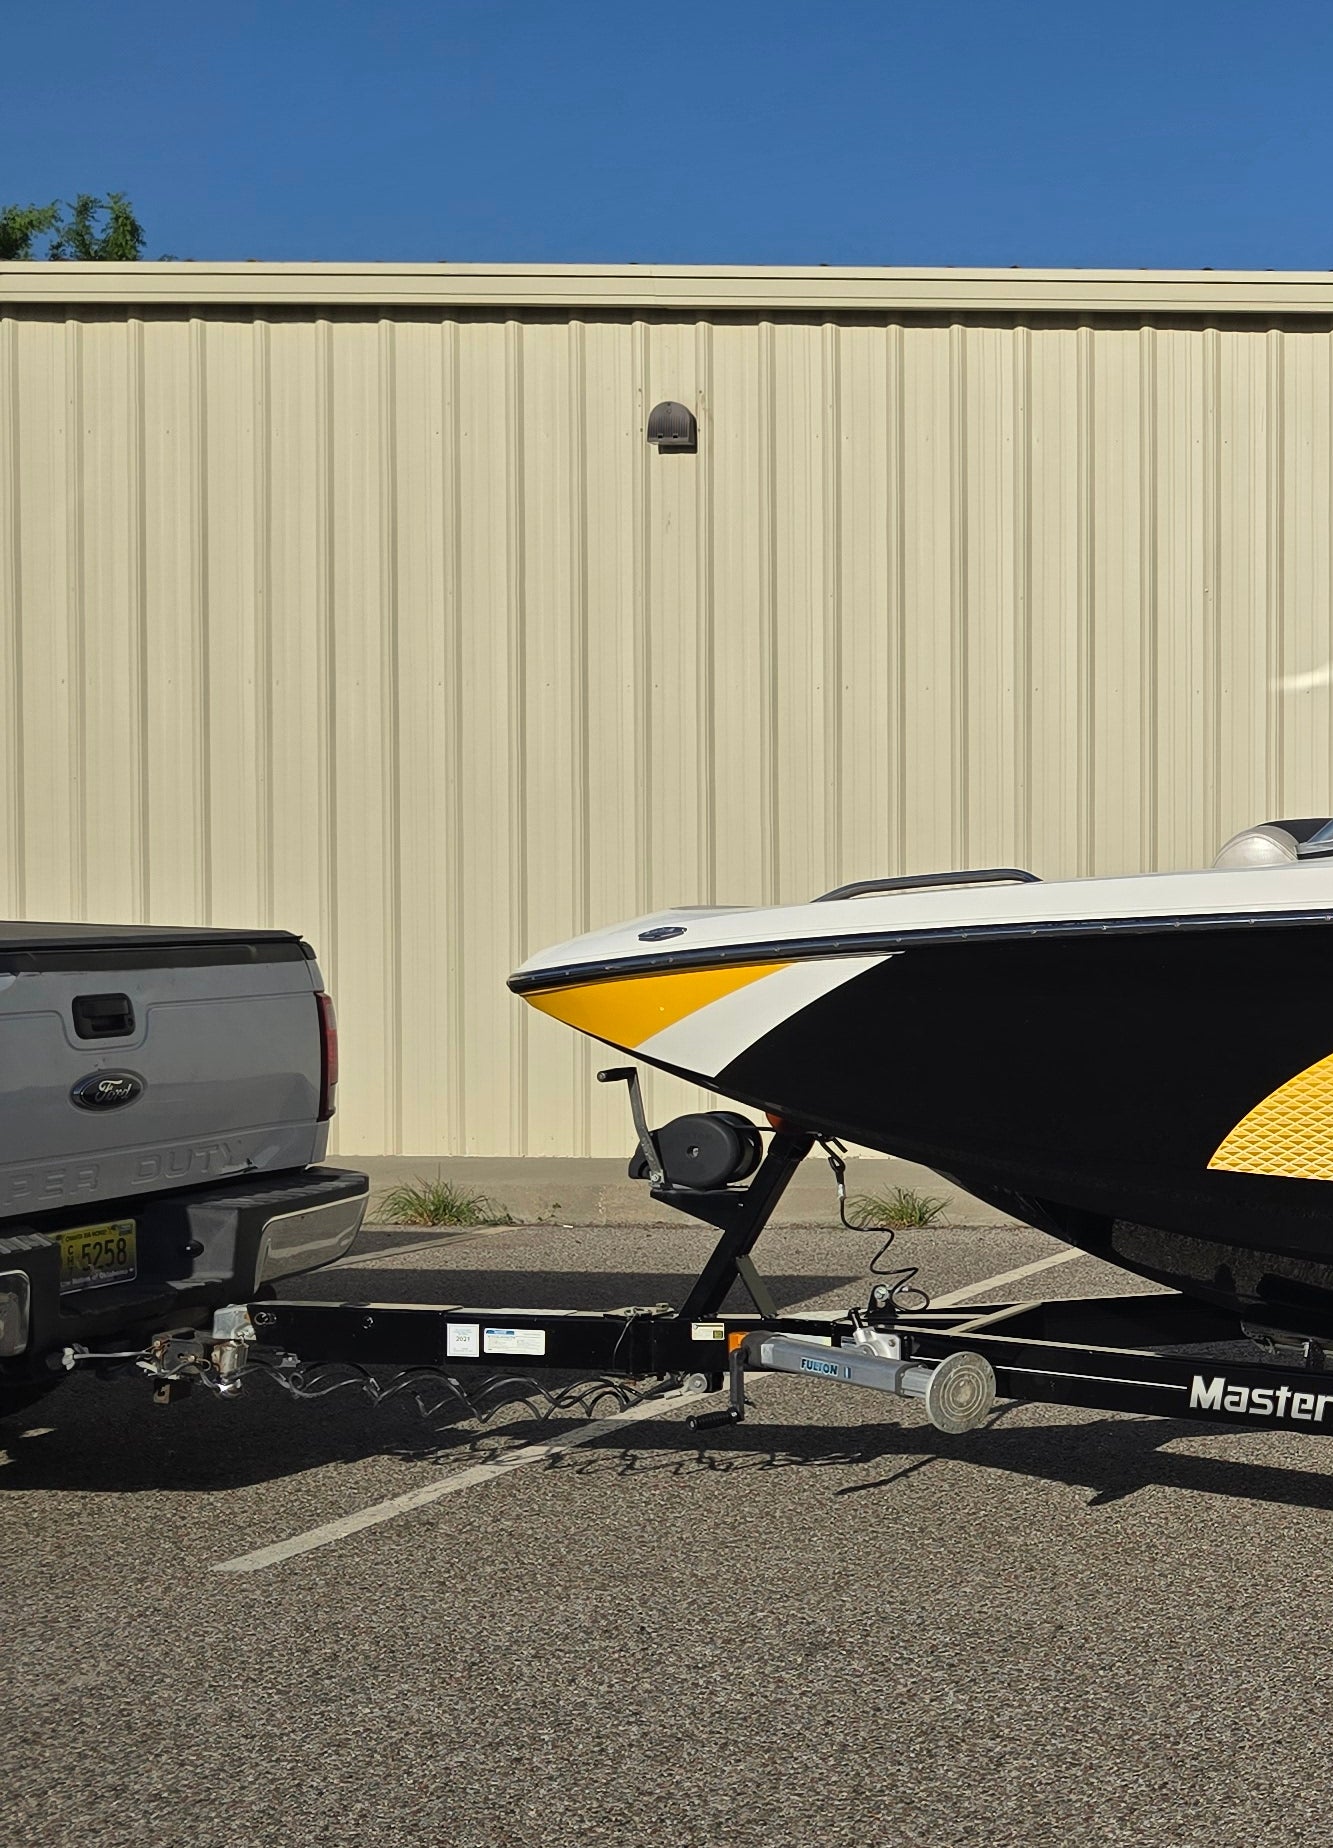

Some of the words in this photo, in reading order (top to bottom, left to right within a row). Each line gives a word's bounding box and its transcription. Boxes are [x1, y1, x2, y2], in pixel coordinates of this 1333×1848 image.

[95, 1079, 132, 1101] Ford
[131, 1139, 243, 1185] DUTY
[81, 1237, 127, 1271] 5258
[801, 1358, 838, 1375] FULTON
